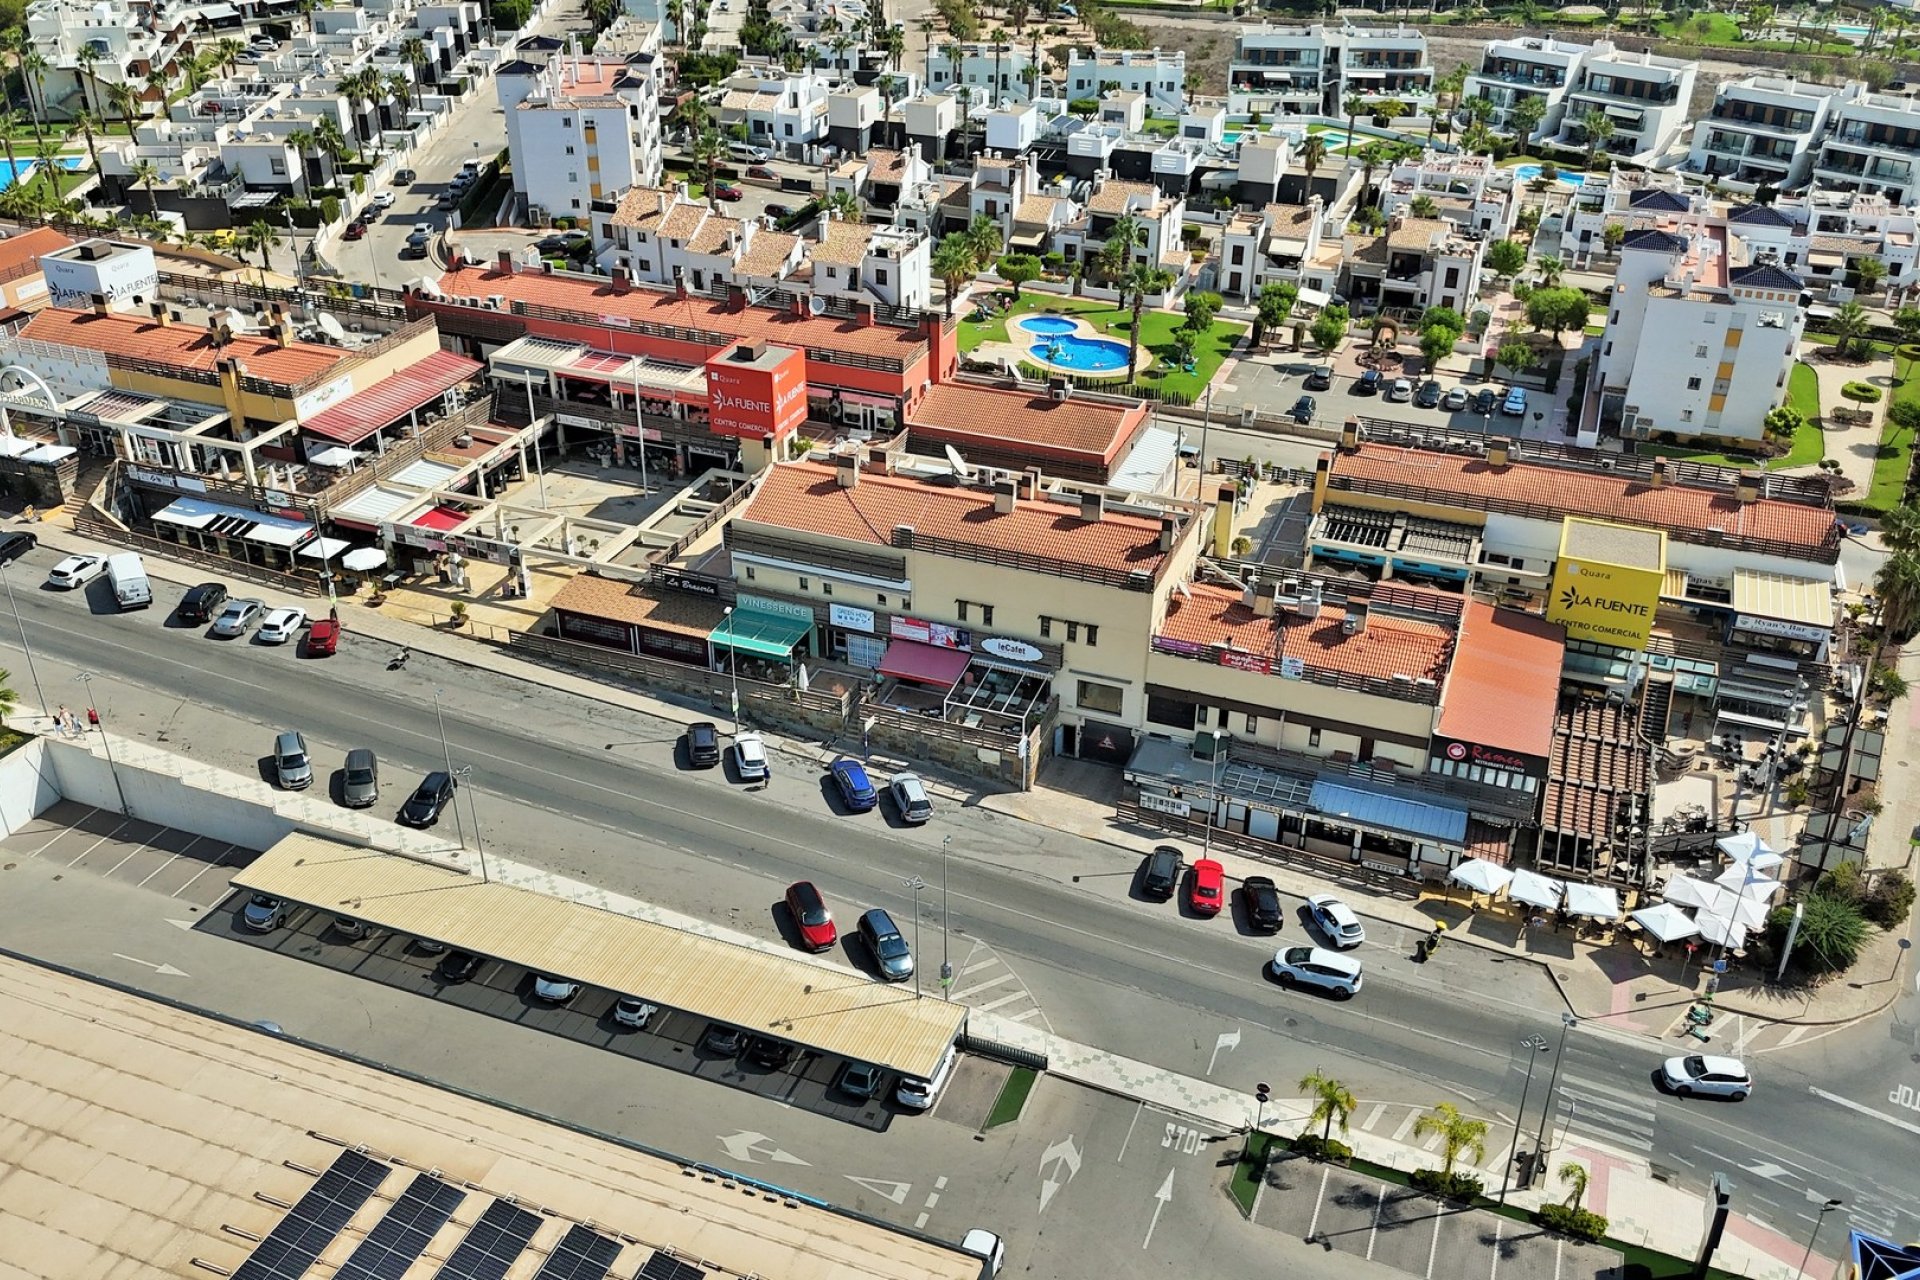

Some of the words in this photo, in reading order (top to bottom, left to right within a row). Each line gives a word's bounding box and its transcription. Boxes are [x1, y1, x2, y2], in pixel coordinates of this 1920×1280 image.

[126, 272, 159, 293] FUENTE
[719, 374, 741, 385] Quara
[722, 395, 735, 408] LA
[734, 399, 771, 414] FUENTE
[713, 417, 738, 429] CENTRO
[738, 421, 771, 433] COMERCIAL
[1580, 567, 1612, 581] Quara
[742, 597, 808, 618] VINESSENCE
[1574, 594, 1592, 608] LA
[1594, 597, 1650, 617] FUENTE
[1554, 617, 1591, 631] CENTRO
[1591, 623, 1643, 640] COMERCIAL
[1753, 618, 1786, 631] Ryan's
[1788, 623, 1807, 633] Bar
[1888, 1083, 1920, 1112] TOP
[1160, 1122, 1210, 1157] STOP
